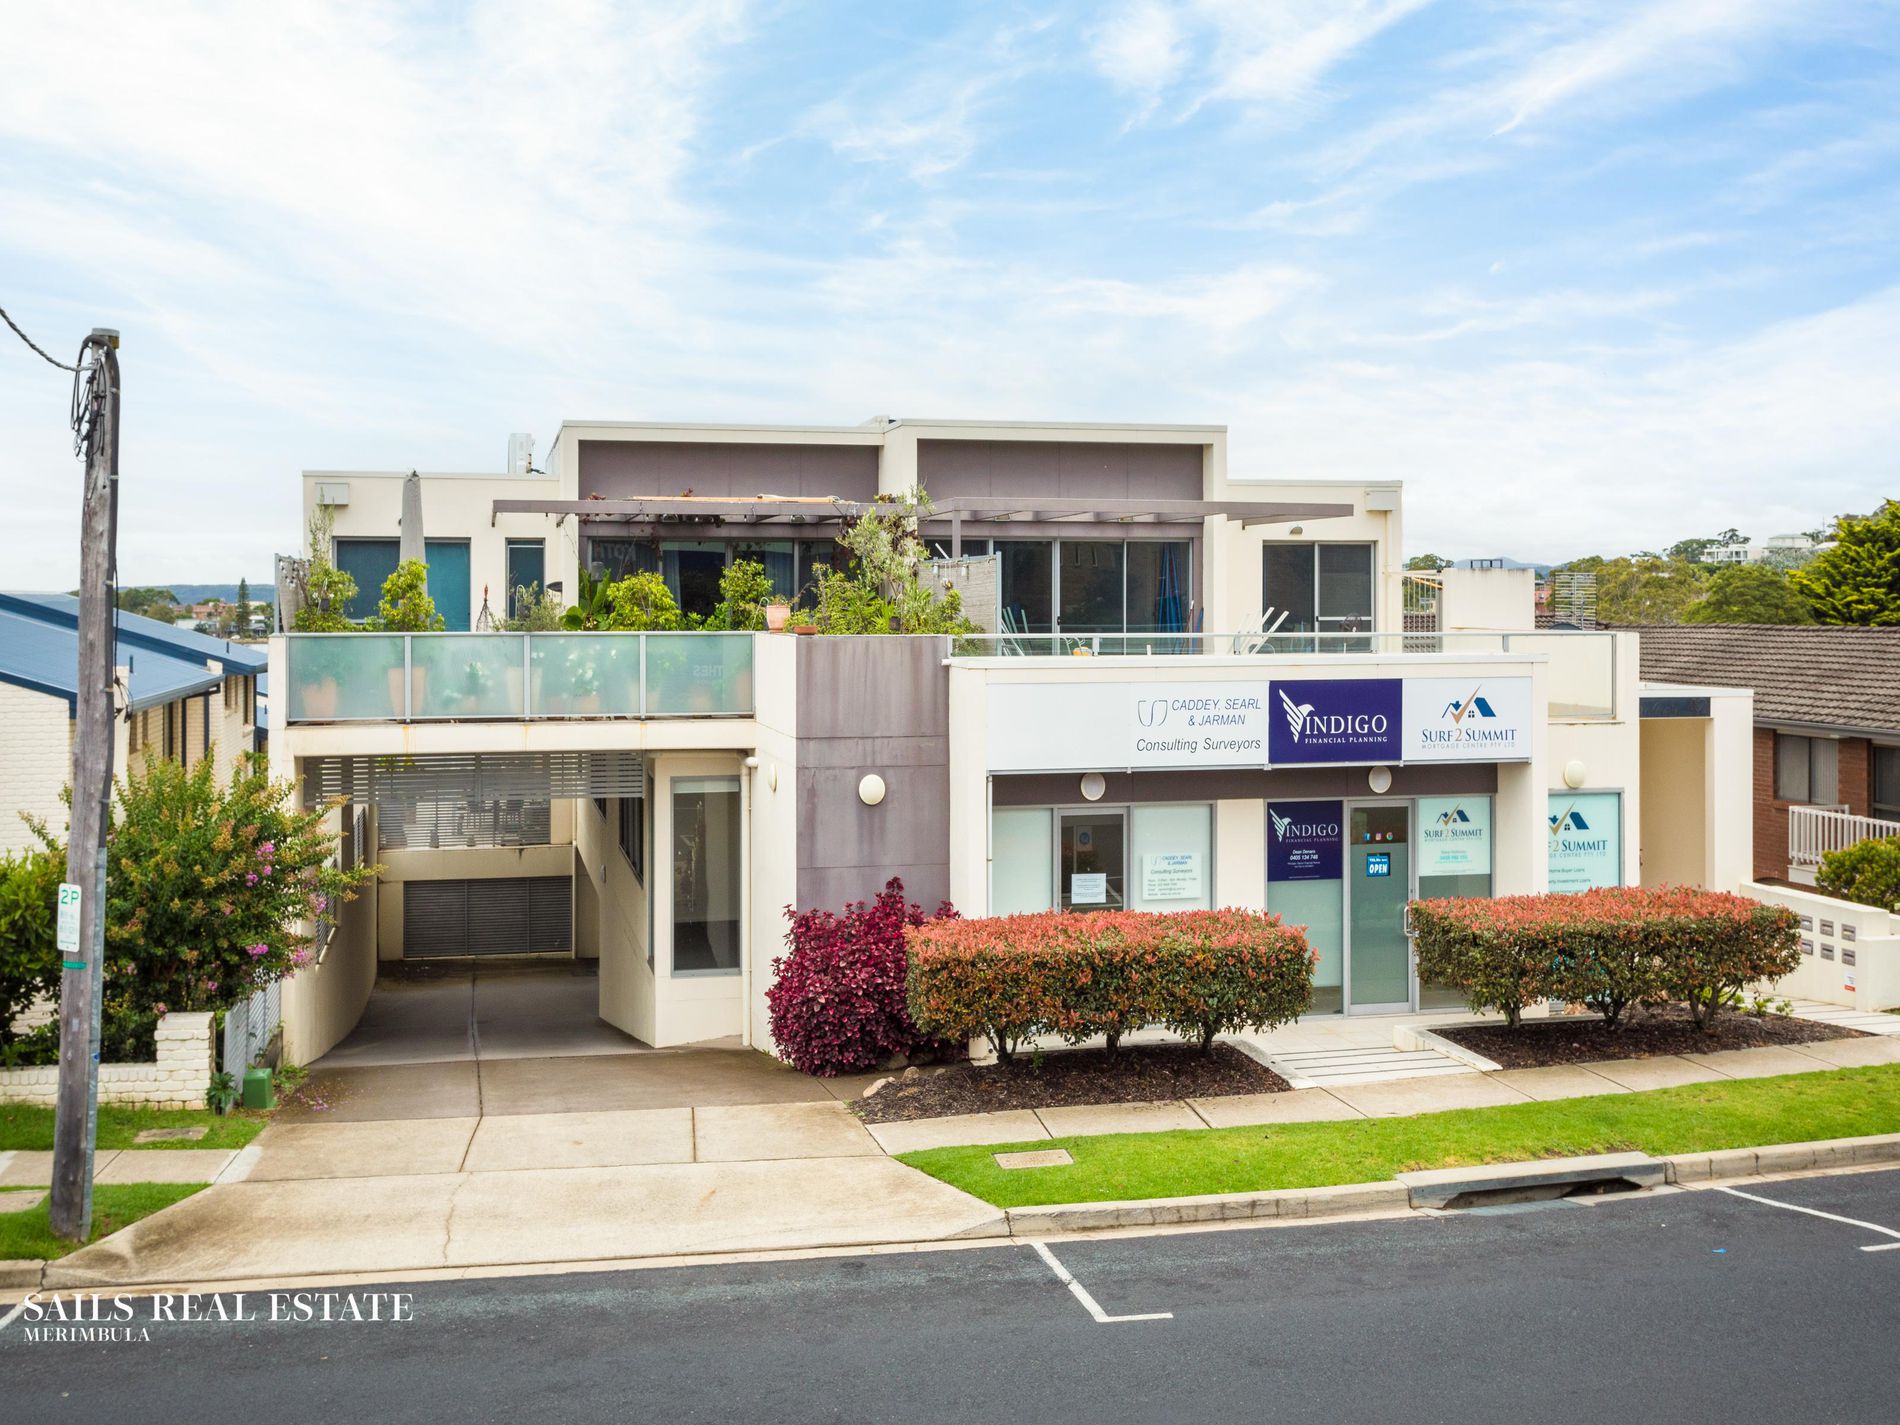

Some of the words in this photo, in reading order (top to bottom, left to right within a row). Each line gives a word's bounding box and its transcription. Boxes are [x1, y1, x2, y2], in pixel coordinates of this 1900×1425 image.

[1224, 698, 1261, 710] SEARL
[1188, 715, 1195, 726] &
[1198, 714, 1246, 726] JARMAN
[1305, 714, 1388, 735] INDIGO
[1421, 728, 1453, 743] SURF
[1455, 727, 1462, 742] 2
[1465, 727, 1517, 742] SUMMIT
[1136, 738, 1198, 753] Consulting
[1203, 737, 1261, 752] Surveyors
[1286, 823, 1339, 837] INDIGO
[1451, 827, 1483, 838] SUMMIT
[1561, 839, 1608, 852] SUMMIT
[1369, 863, 1388, 874] OPEN
[60, 889, 80, 905] 2P
